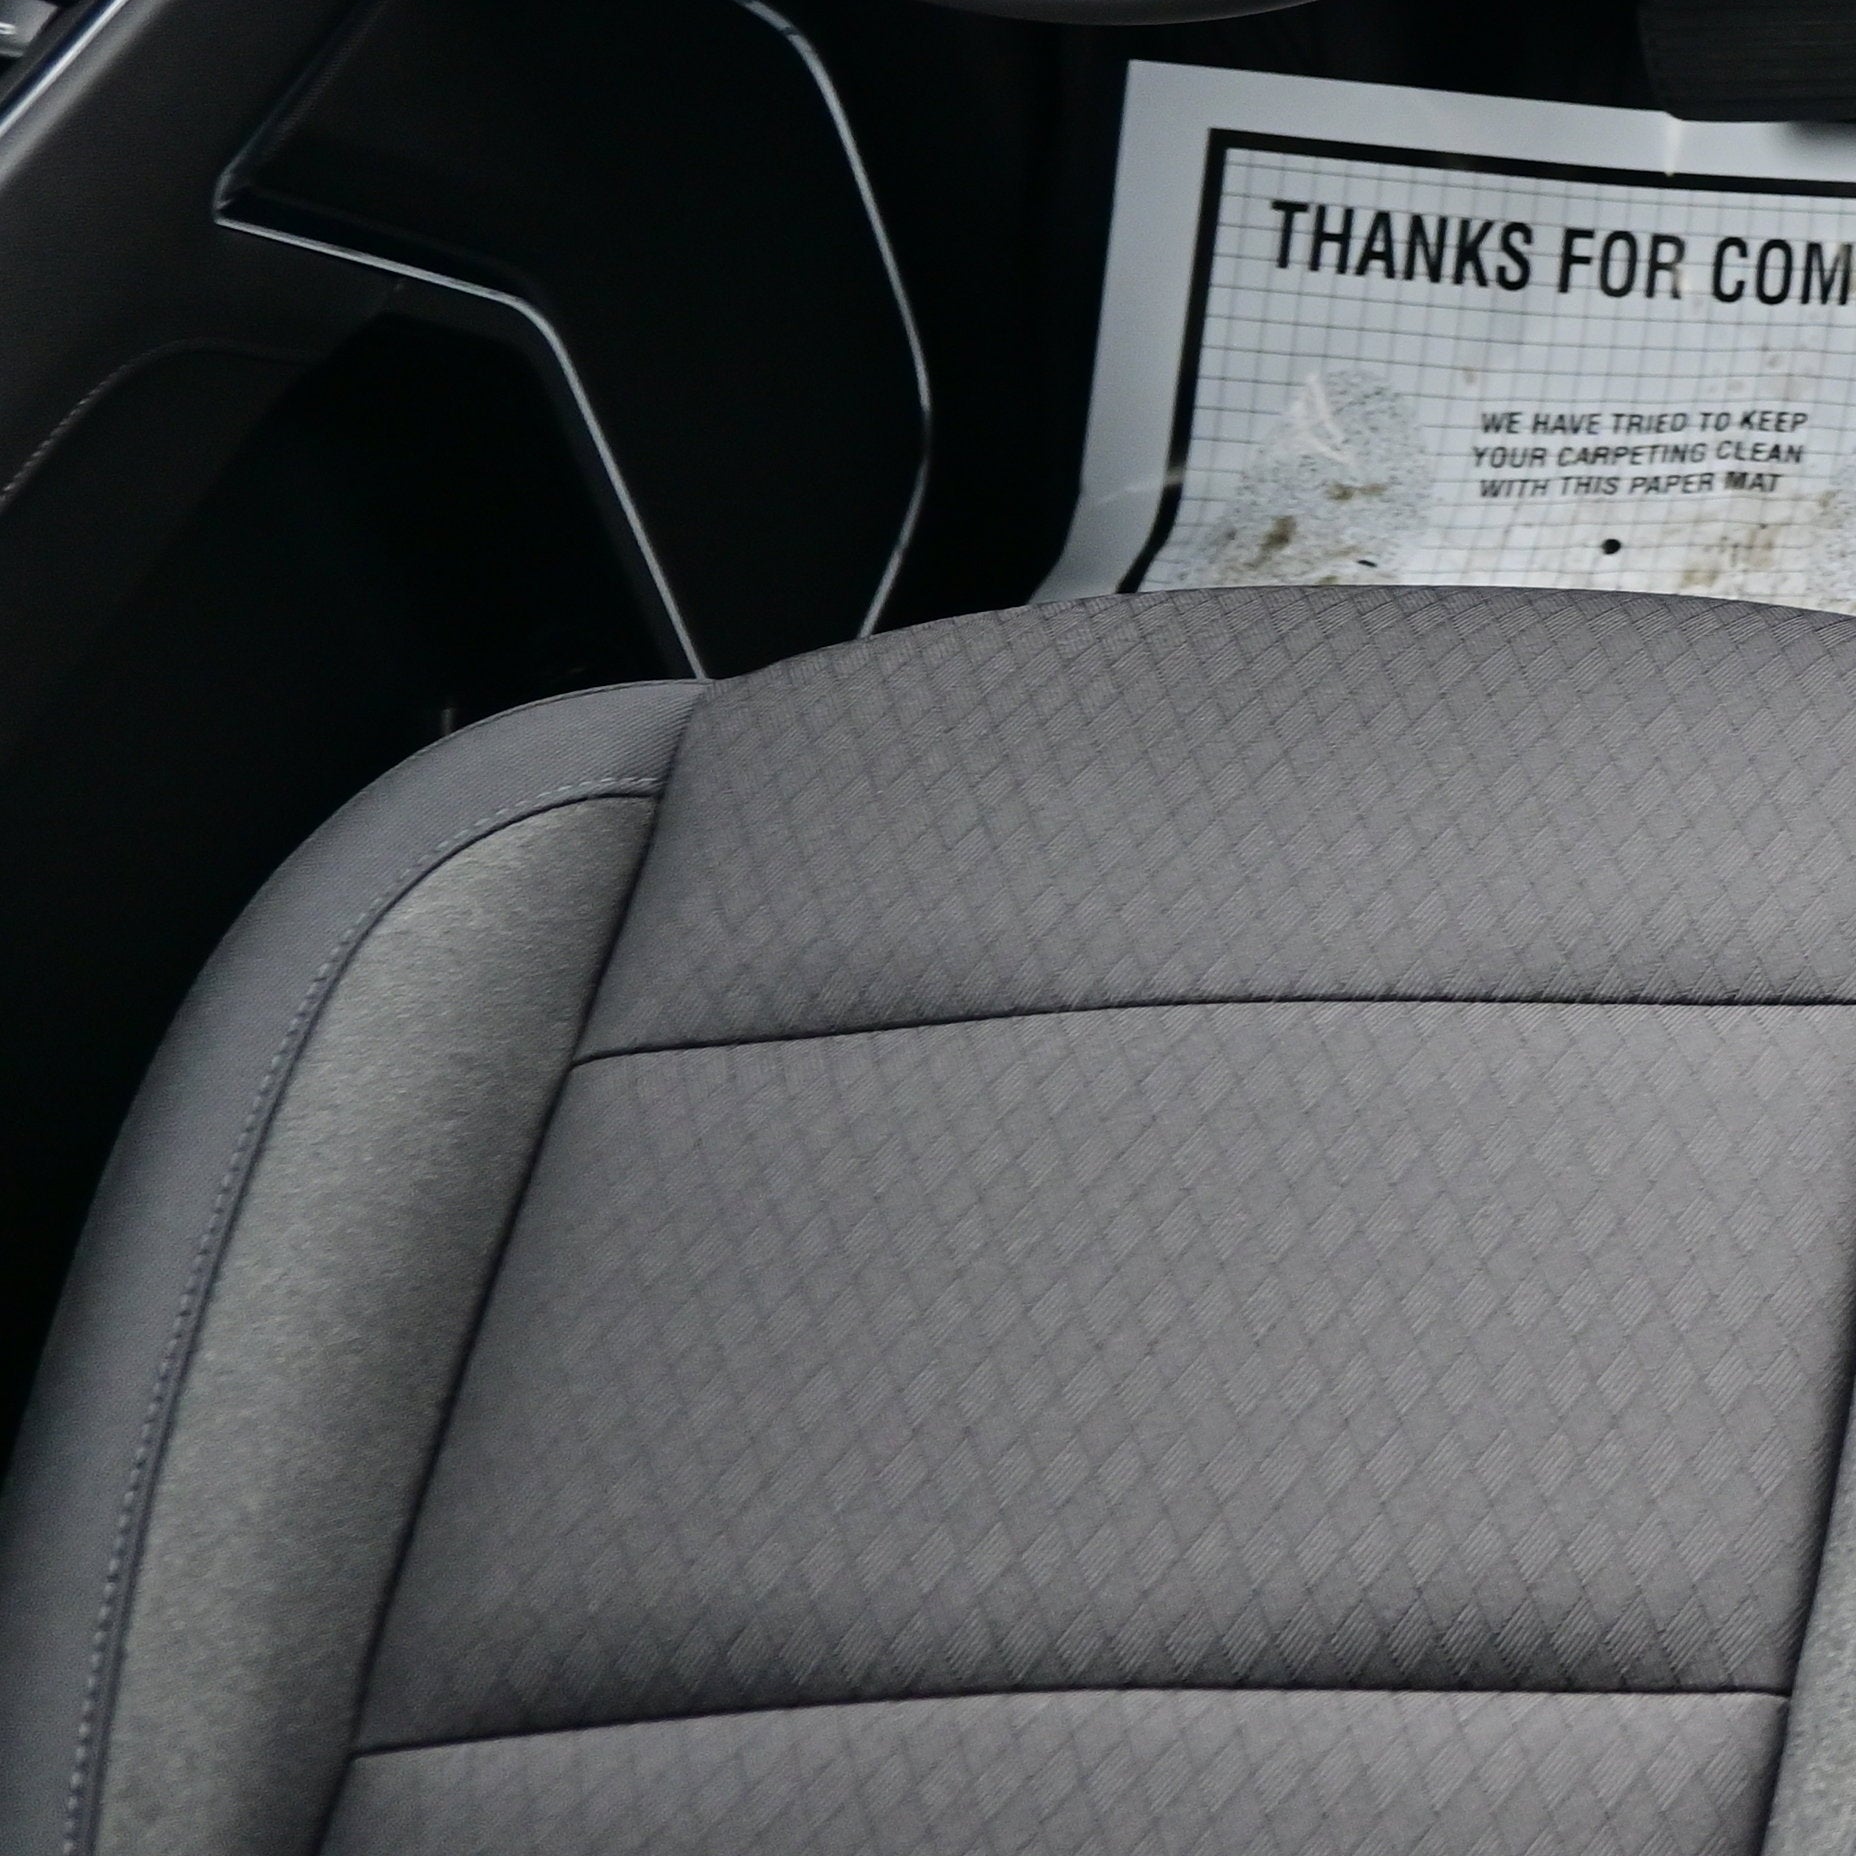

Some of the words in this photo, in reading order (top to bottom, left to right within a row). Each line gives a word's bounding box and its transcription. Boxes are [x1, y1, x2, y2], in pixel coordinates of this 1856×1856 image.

[1271, 199, 1535, 292] THANKS
[1558, 229, 1684, 300] FOR
[1481, 412, 1522, 434] WE
[1531, 412, 1603, 435] HAVE
[1612, 412, 1690, 434] TRIED
[1700, 412, 1732, 432] TO
[1740, 410, 1808, 432] KEEP
[1472, 446, 1547, 468] YOUR
[1557, 443, 1708, 468] CARPETING
[1716, 440, 1804, 464] CLEAN
[1479, 478, 1549, 498] WITH
[1559, 476, 1621, 496] THIS
[1629, 473, 1715, 495] PAPER
[1724, 471, 1782, 493] MAT
